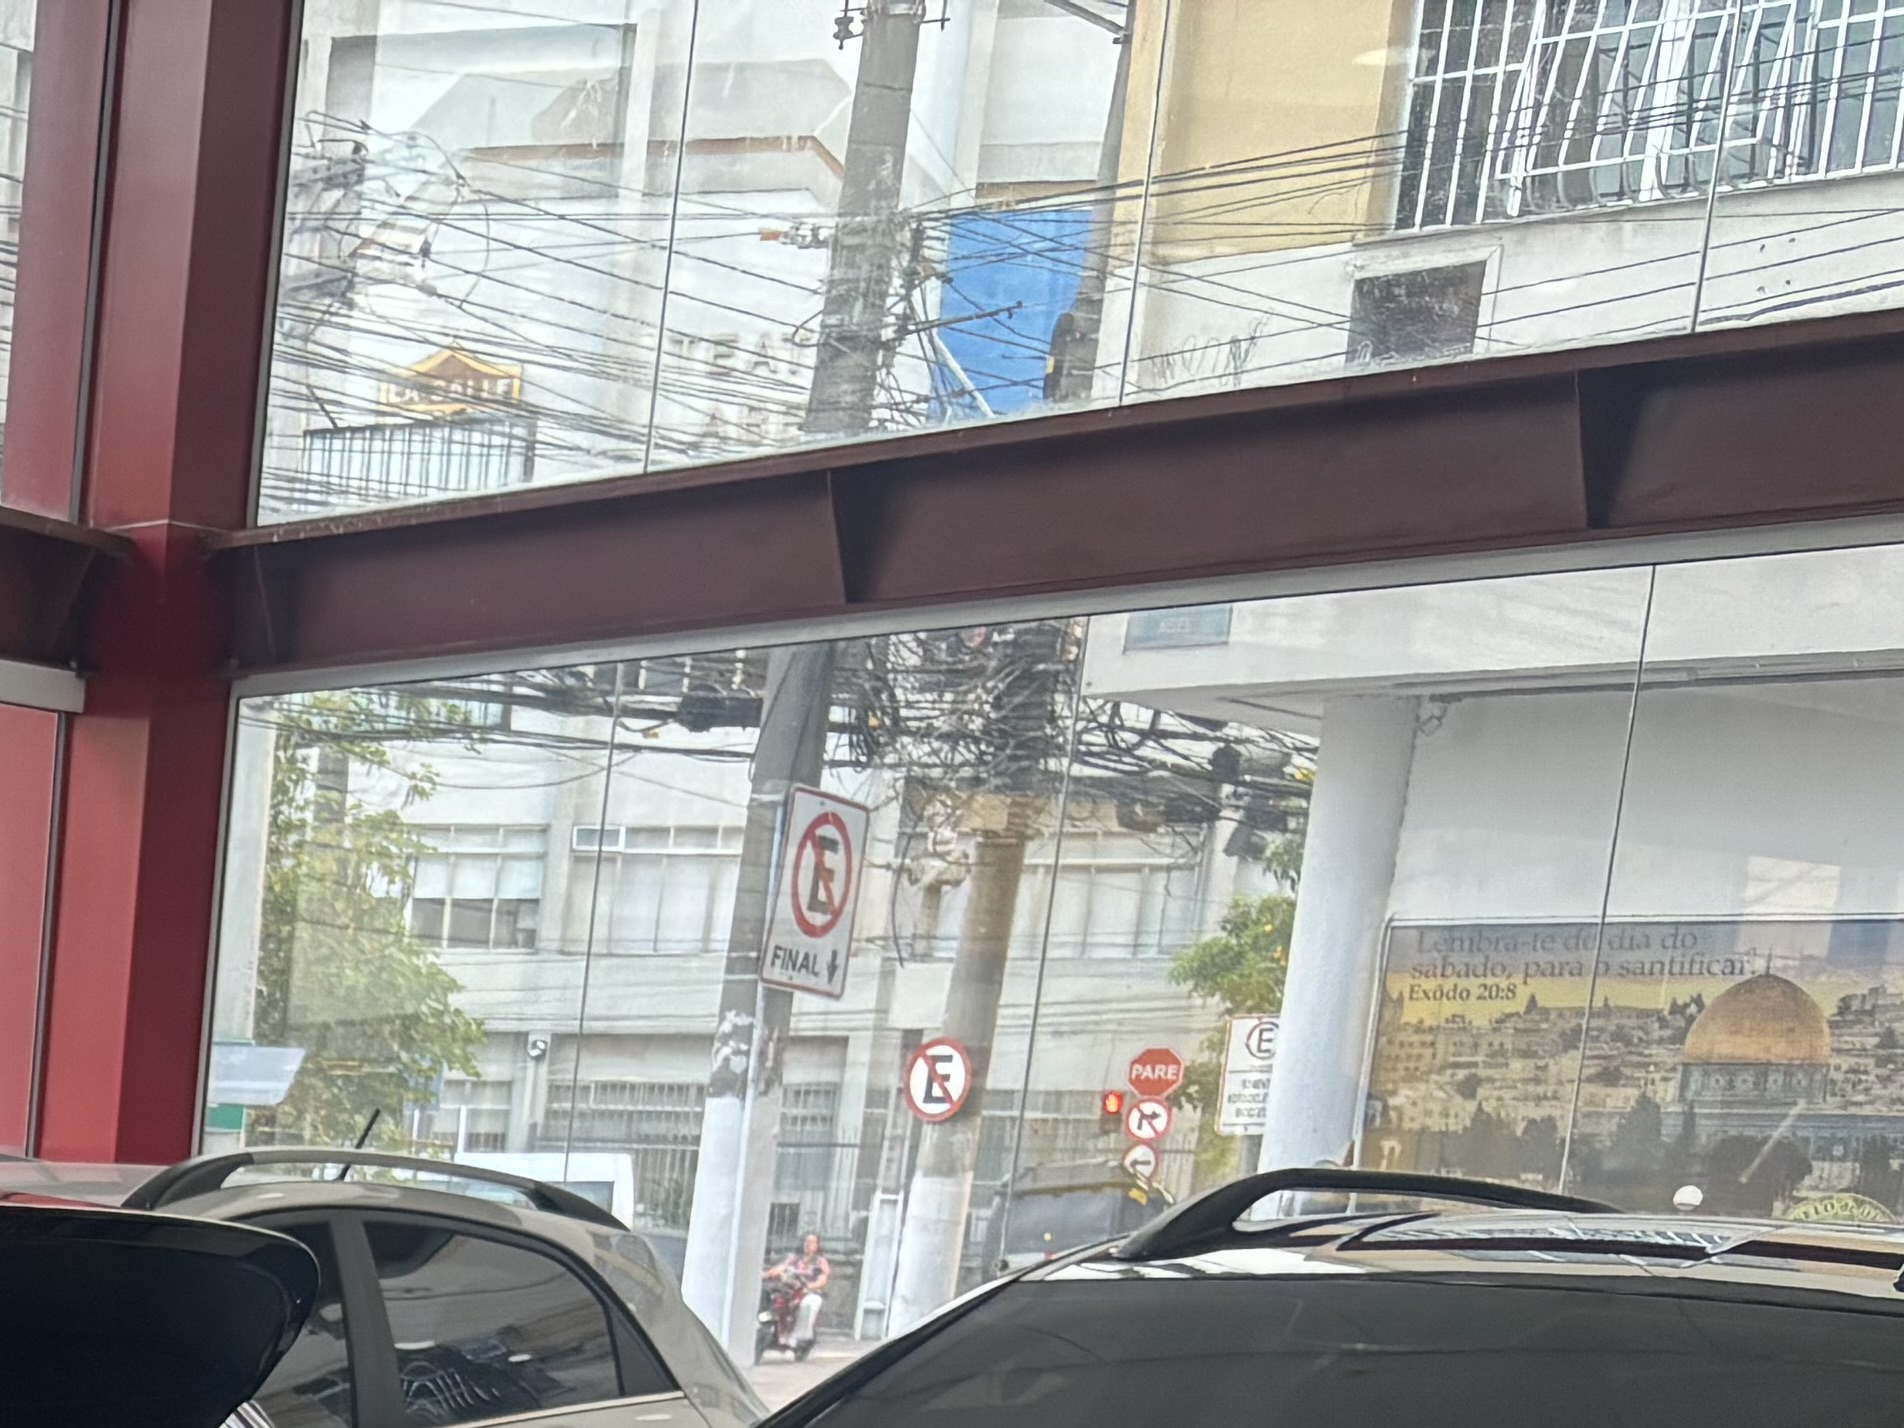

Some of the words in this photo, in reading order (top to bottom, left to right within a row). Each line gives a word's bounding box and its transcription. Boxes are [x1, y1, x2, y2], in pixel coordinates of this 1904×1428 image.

[669, 333, 814, 373] TEAT
[1608, 926, 1651, 951] dia
[1662, 926, 1698, 951] do
[770, 945, 820, 978] FINAL
[1523, 957, 1584, 984] para
[1476, 982, 1517, 1001] 20:8
[1130, 1063, 1178, 1081] PARE
